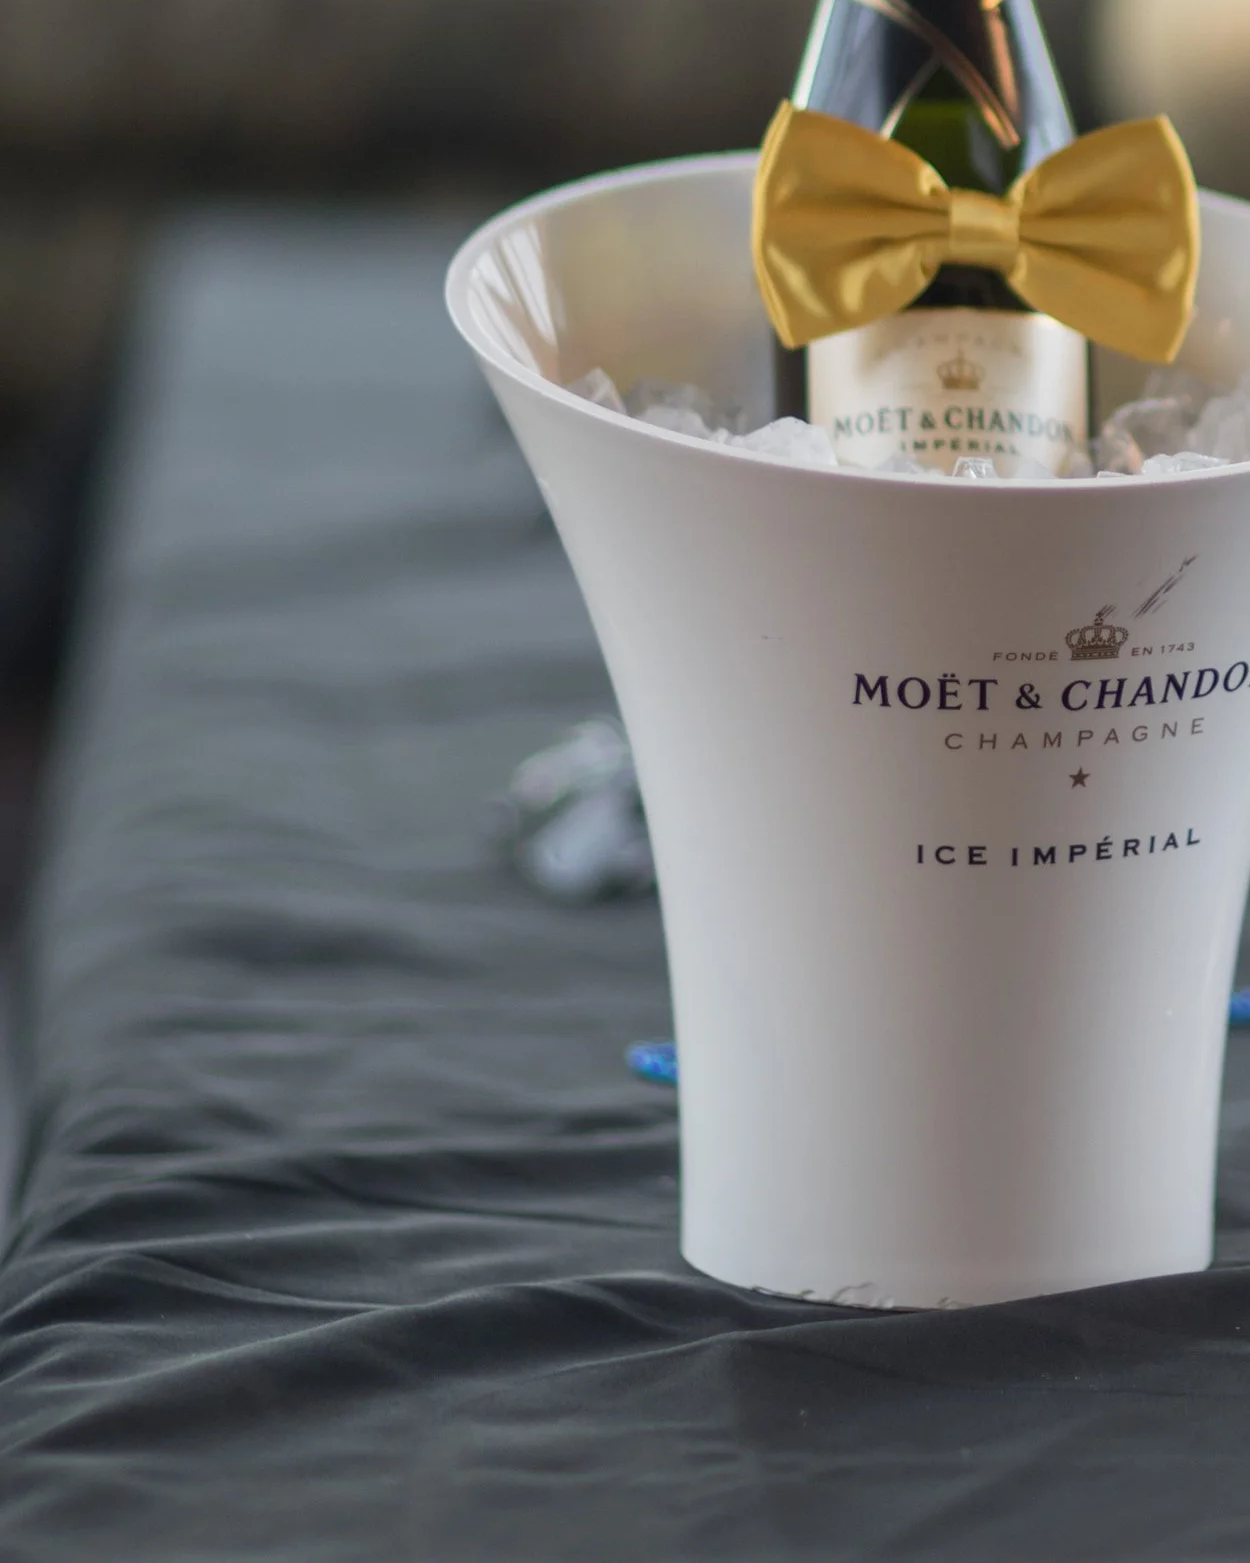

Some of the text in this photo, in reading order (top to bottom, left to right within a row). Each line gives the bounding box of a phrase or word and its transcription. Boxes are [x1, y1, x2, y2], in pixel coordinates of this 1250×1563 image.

[918, 411, 937, 431] &
[1131, 646, 1153, 656] EN
[1160, 642, 1195, 654] 1743
[852, 673, 998, 711] MOËT
[1014, 682, 1043, 710] &
[944, 717, 1206, 750] CHAMPAGNE
[916, 828, 1200, 867] ICE IMPÉRIAL
